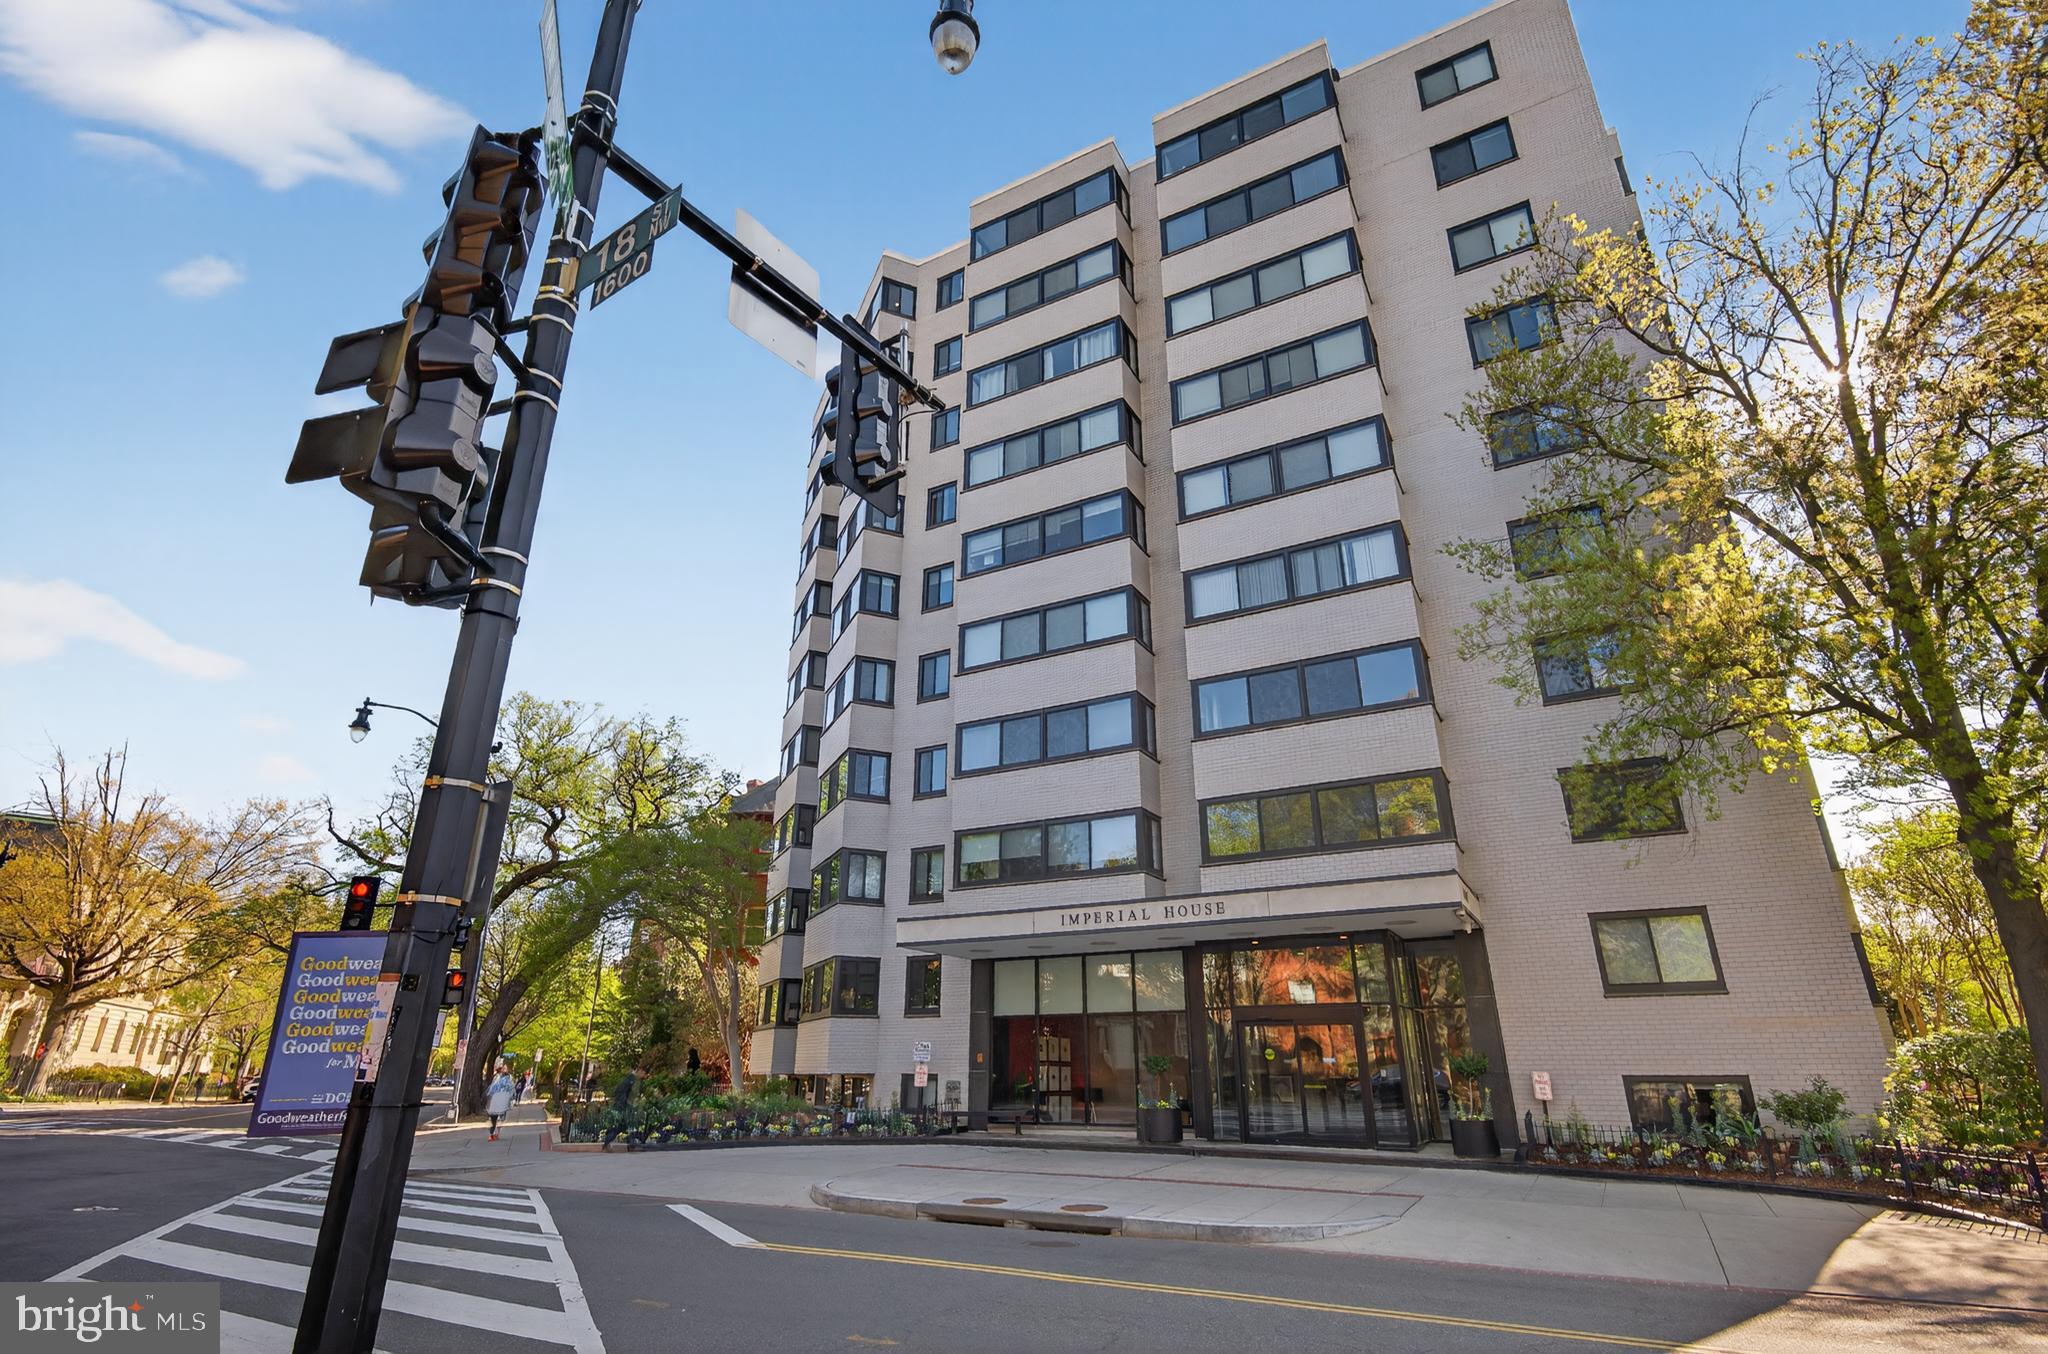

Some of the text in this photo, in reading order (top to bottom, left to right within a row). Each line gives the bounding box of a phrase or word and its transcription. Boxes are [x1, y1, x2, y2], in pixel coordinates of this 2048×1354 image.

[653, 195, 674, 222] ST
[649, 210, 671, 241] NW
[596, 223, 637, 274] 18
[594, 251, 648, 305] 1600
[1061, 902, 1226, 926] IMPERIAL HOUSE
[326, 1057, 342, 1069] for
